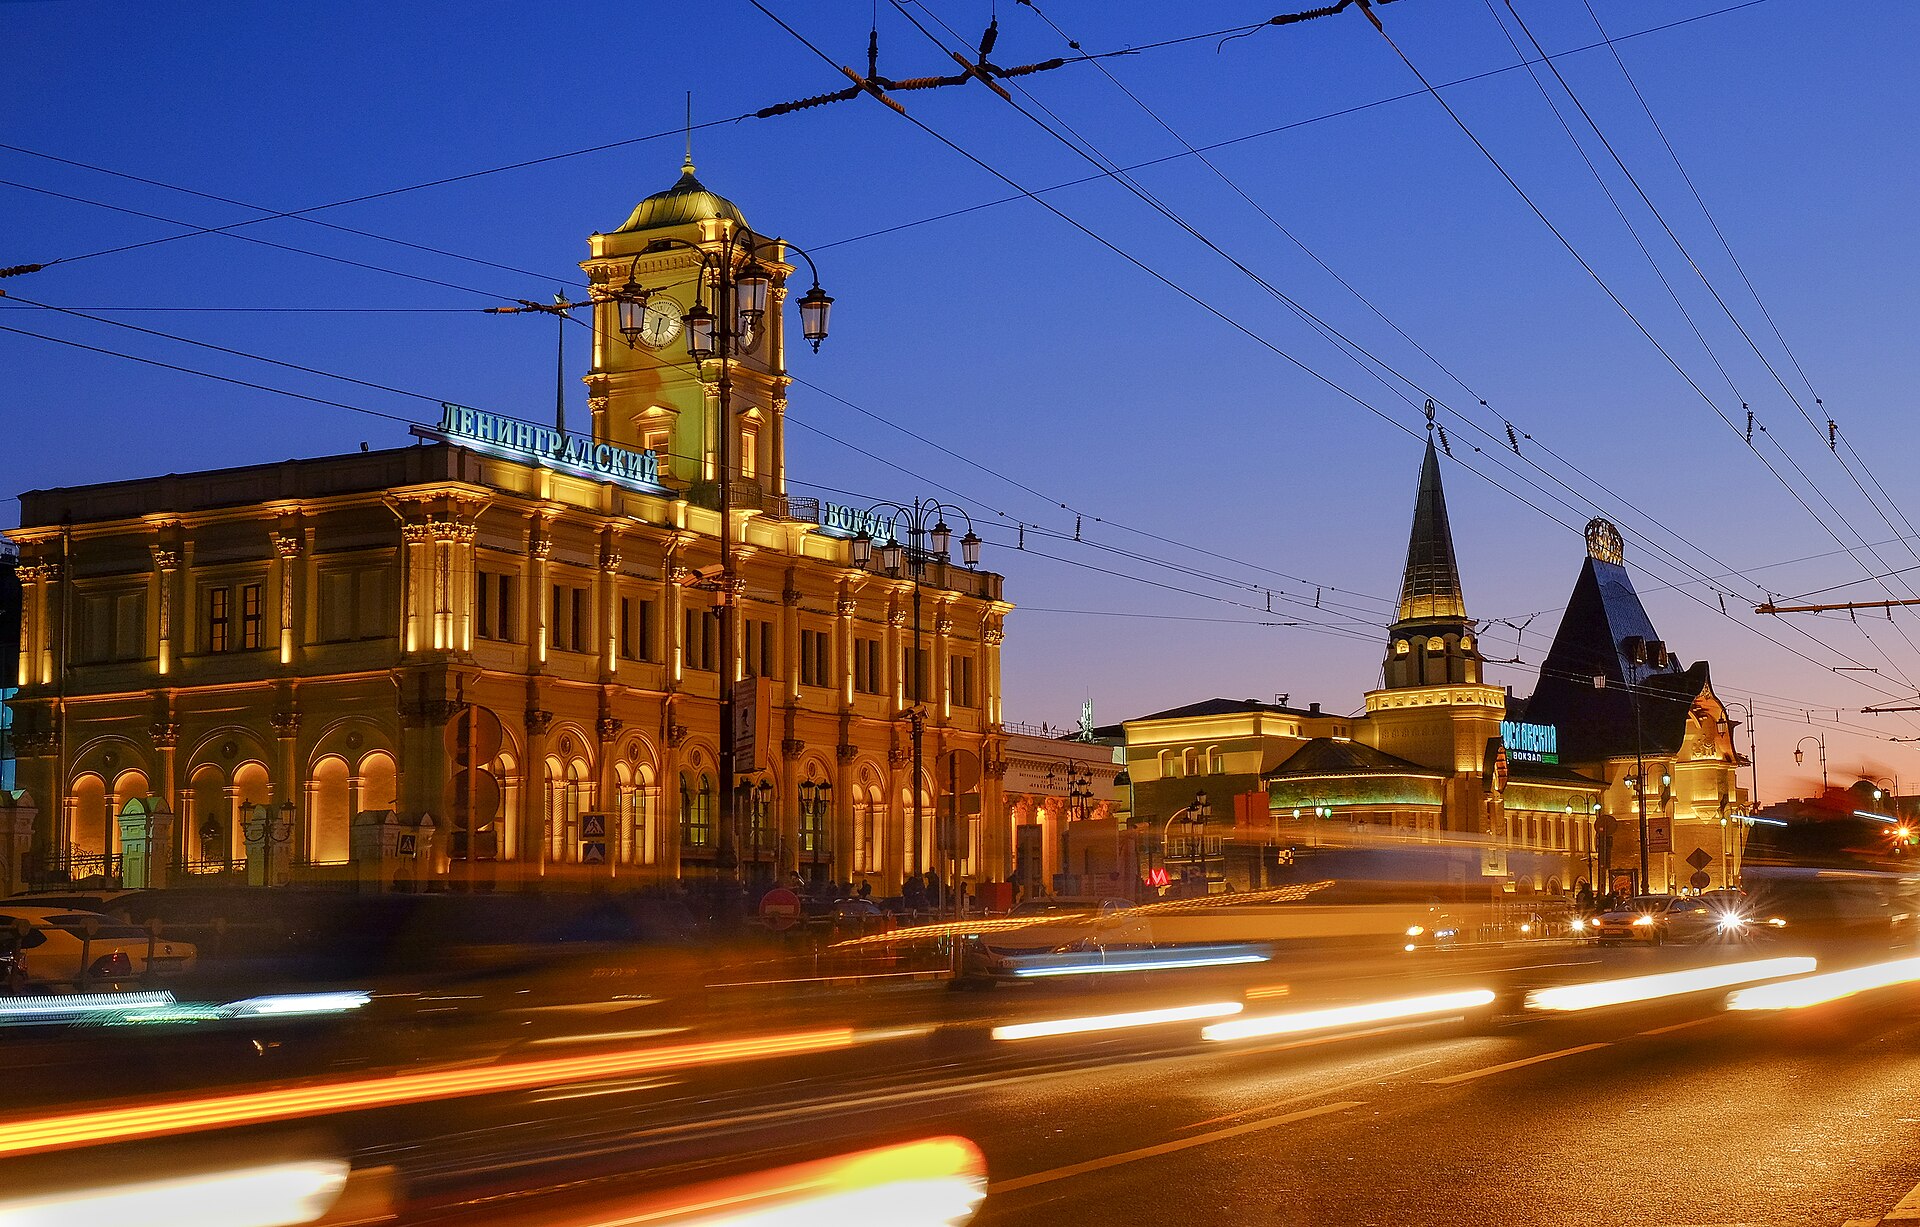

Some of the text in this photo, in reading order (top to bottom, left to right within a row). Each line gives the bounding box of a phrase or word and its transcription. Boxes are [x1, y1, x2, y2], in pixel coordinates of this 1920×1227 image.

[440, 402, 898, 541] ЛЕНИНГРАДСКИЙ ВОКЗАЛ
[1512, 751, 1542, 762] ВОКЗАЛ
